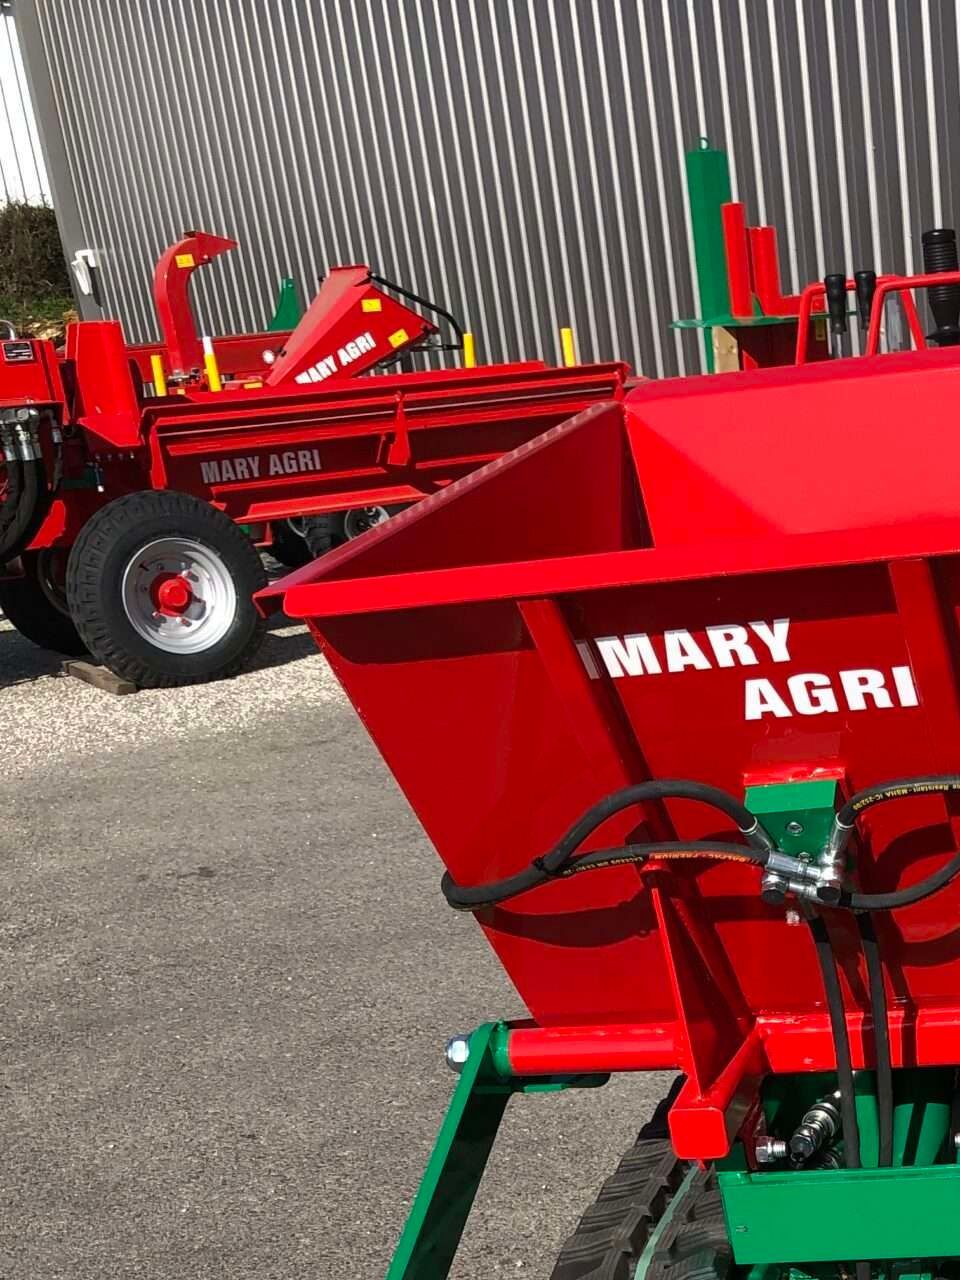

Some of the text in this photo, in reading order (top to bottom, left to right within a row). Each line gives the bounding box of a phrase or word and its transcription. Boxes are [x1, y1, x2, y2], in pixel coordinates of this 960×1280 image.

[294, 331, 376, 384] MARY AGRI
[200, 449, 322, 484] MARY AGRI
[594, 618, 919, 720] MARY AGRI
[912, 784, 949, 793] Resistant
